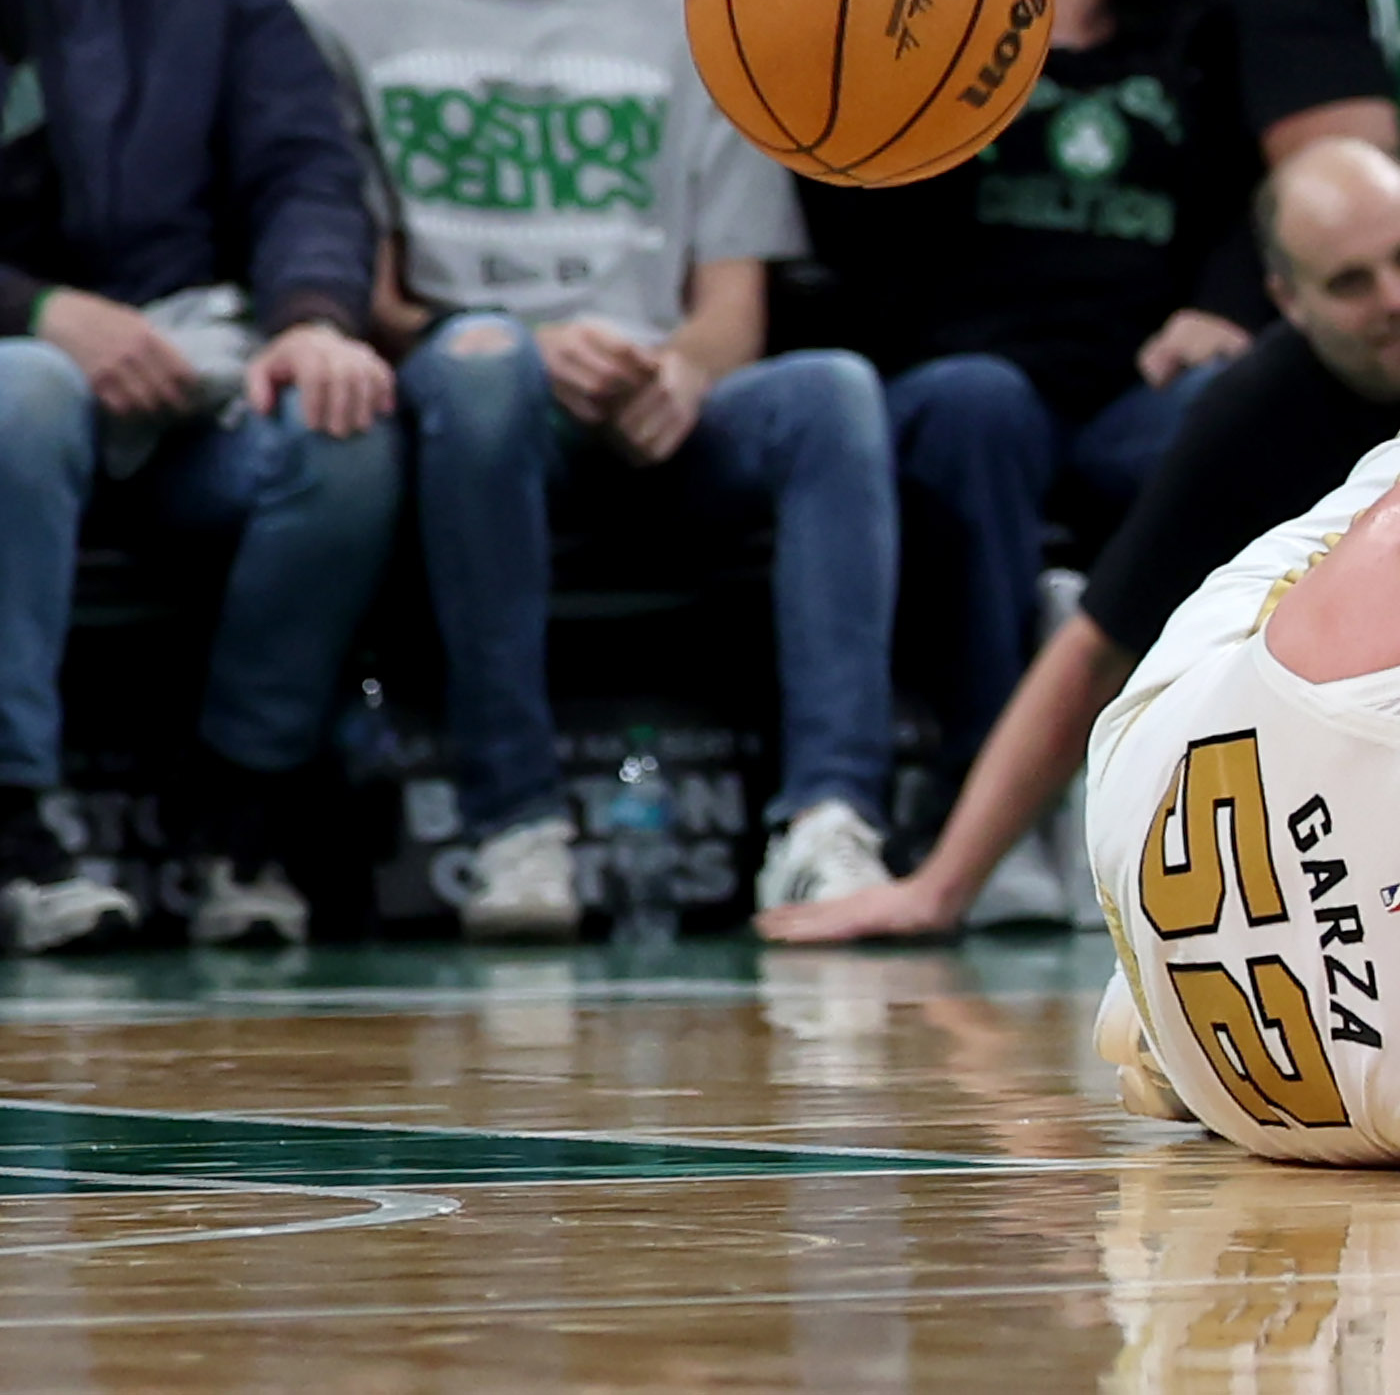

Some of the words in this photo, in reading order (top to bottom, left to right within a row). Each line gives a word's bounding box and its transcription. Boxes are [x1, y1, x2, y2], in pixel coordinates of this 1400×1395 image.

[380, 85, 668, 160] BOSTON
[1139, 728, 1352, 1129] 52
[1288, 793, 1383, 1049] GARZA
